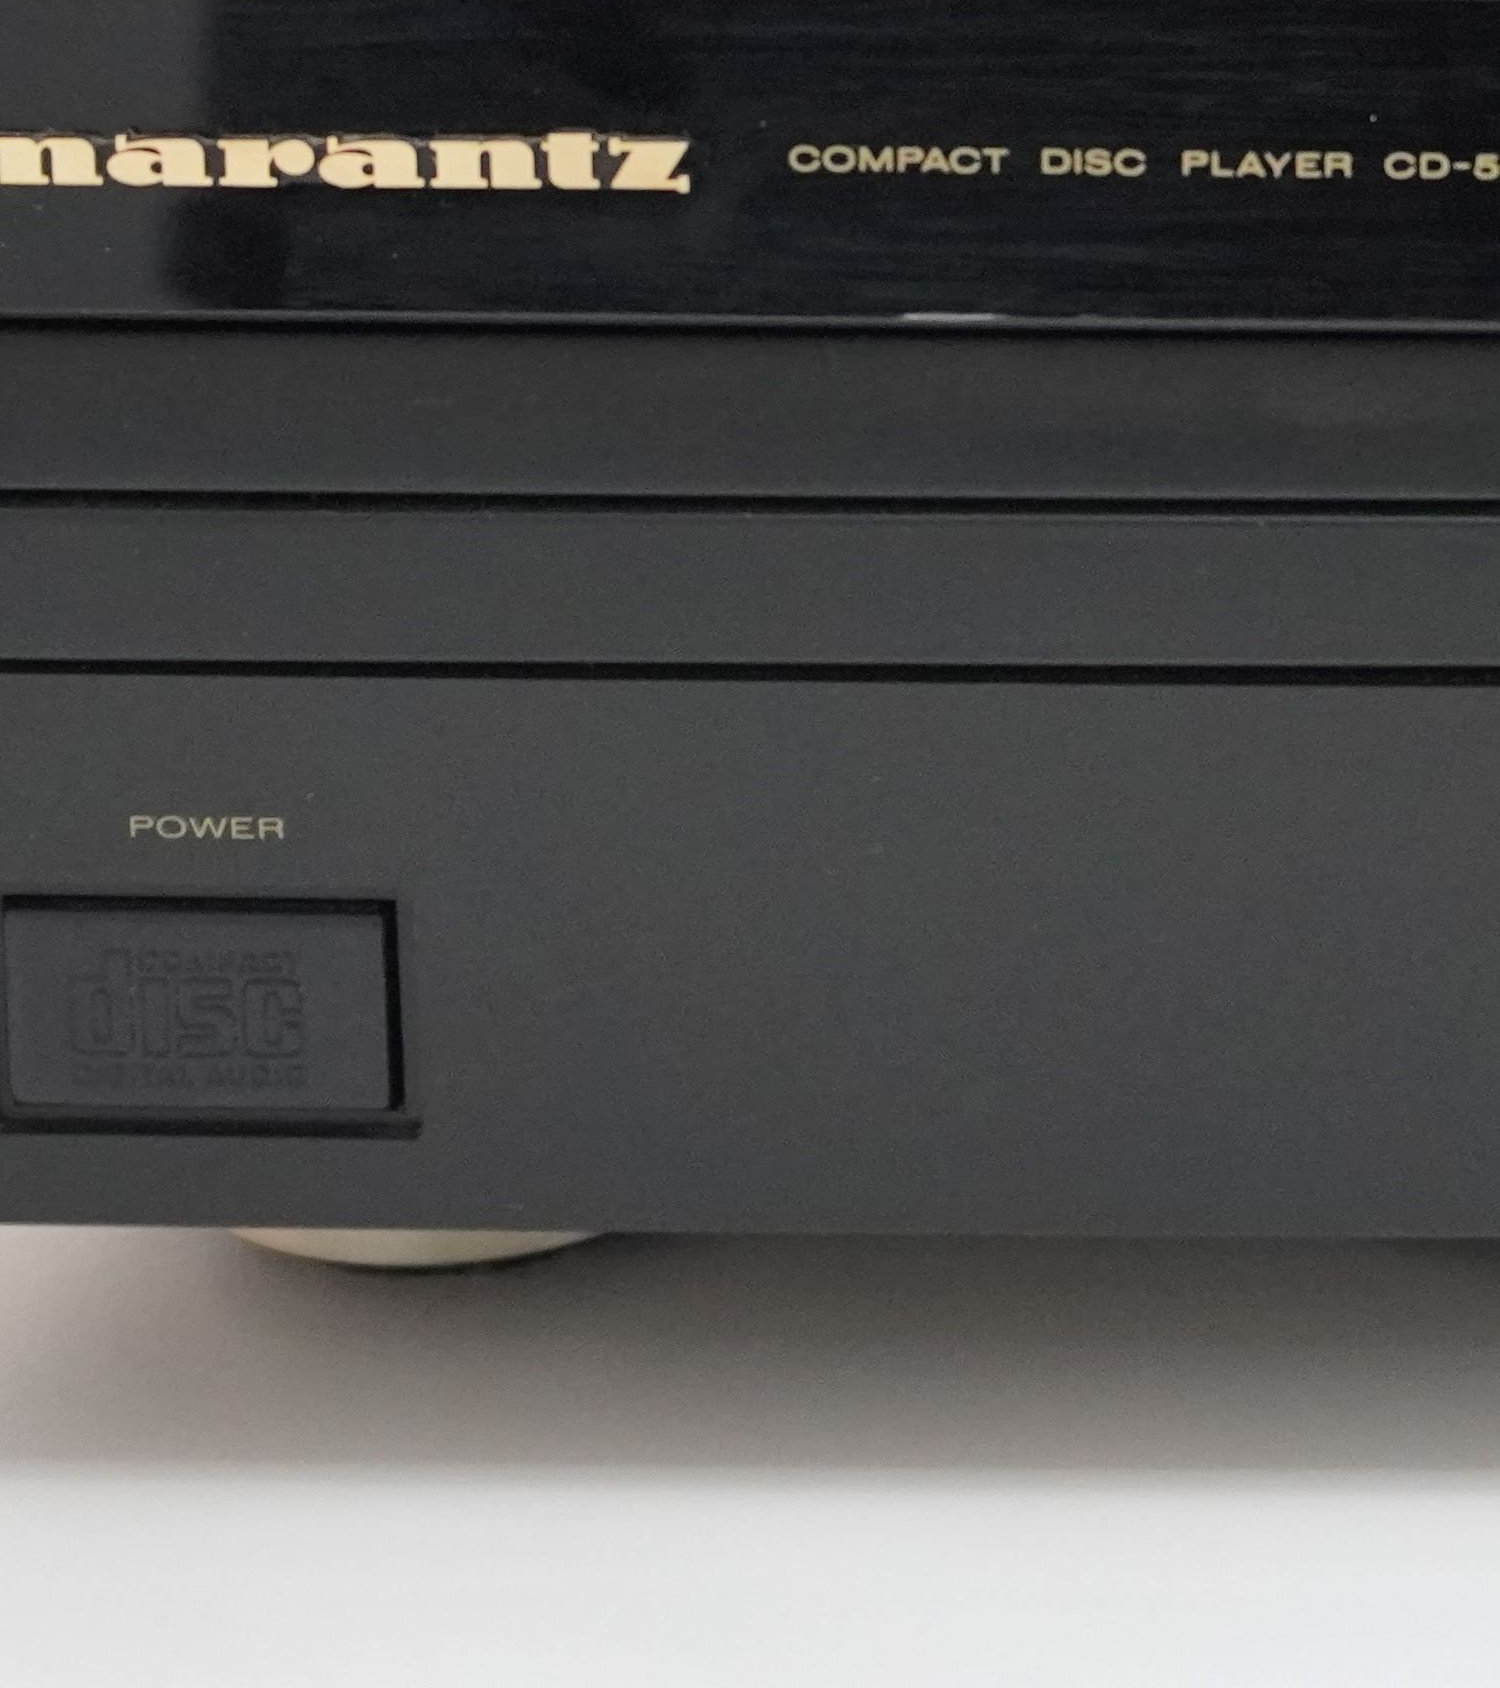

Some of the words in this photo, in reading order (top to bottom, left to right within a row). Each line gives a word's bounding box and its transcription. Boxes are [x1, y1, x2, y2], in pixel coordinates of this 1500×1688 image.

[788, 144, 1010, 175] COMPACT
[1040, 147, 1147, 177] DISC
[1181, 149, 1353, 179] PLAYER
[129, 815, 285, 840] POWER
